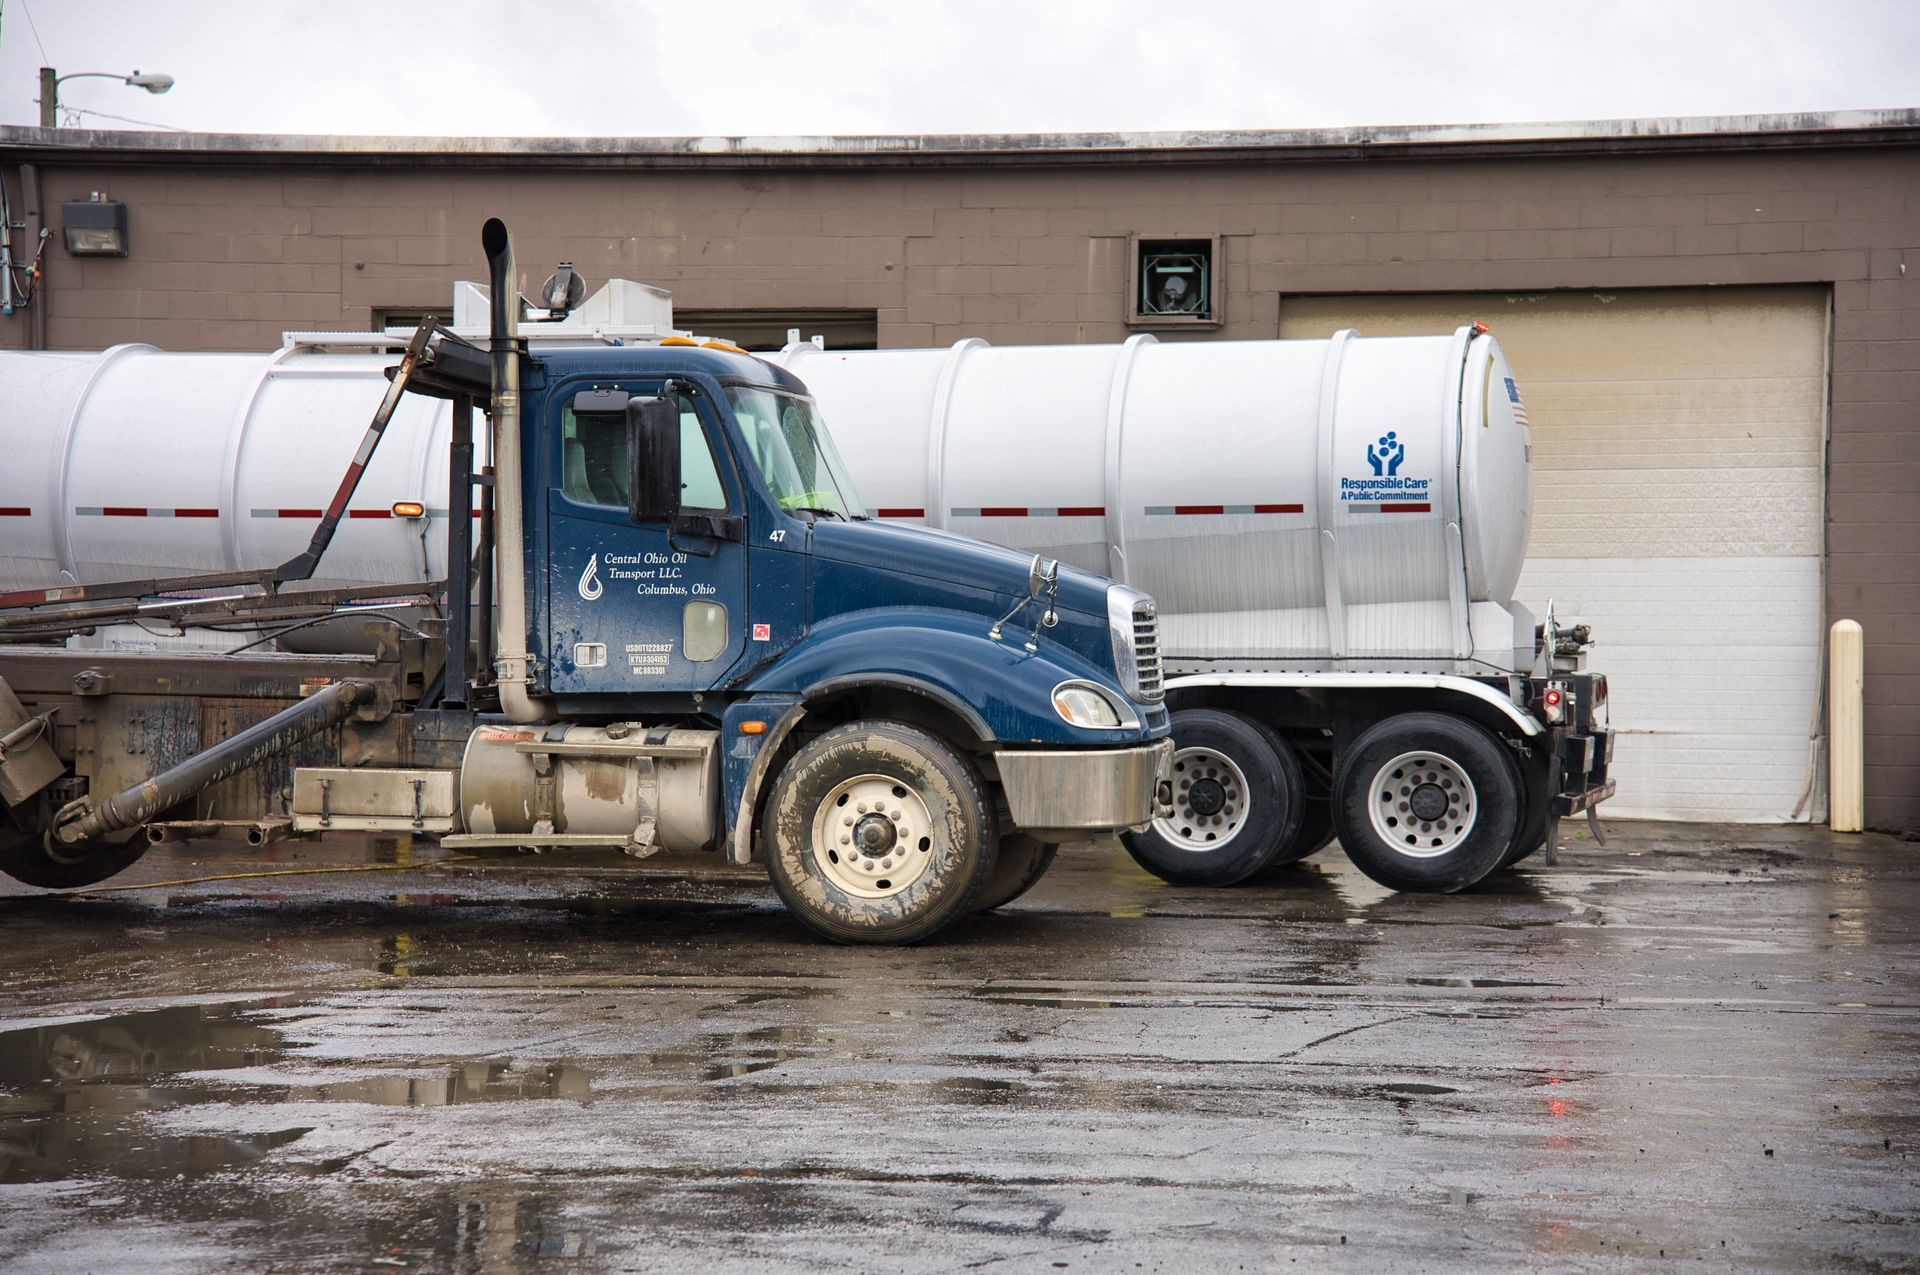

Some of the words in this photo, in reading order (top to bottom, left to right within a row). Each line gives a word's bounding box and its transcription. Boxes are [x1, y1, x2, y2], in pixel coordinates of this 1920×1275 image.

[1341, 477, 1403, 491] Responsible
[1404, 477, 1428, 489] Care
[1341, 491, 1347, 500] A
[1348, 491, 1373, 500] Public
[1374, 491, 1428, 500] Commitment
[769, 530, 786, 542] 47
[604, 552, 641, 564] Central
[644, 552, 668, 564] Ohio
[671, 552, 688, 564] Oil
[608, 567, 655, 580] Transport
[659, 567, 682, 578] LLC.
[637, 583, 688, 596] Columbus,
[691, 583, 716, 595] Ohio
